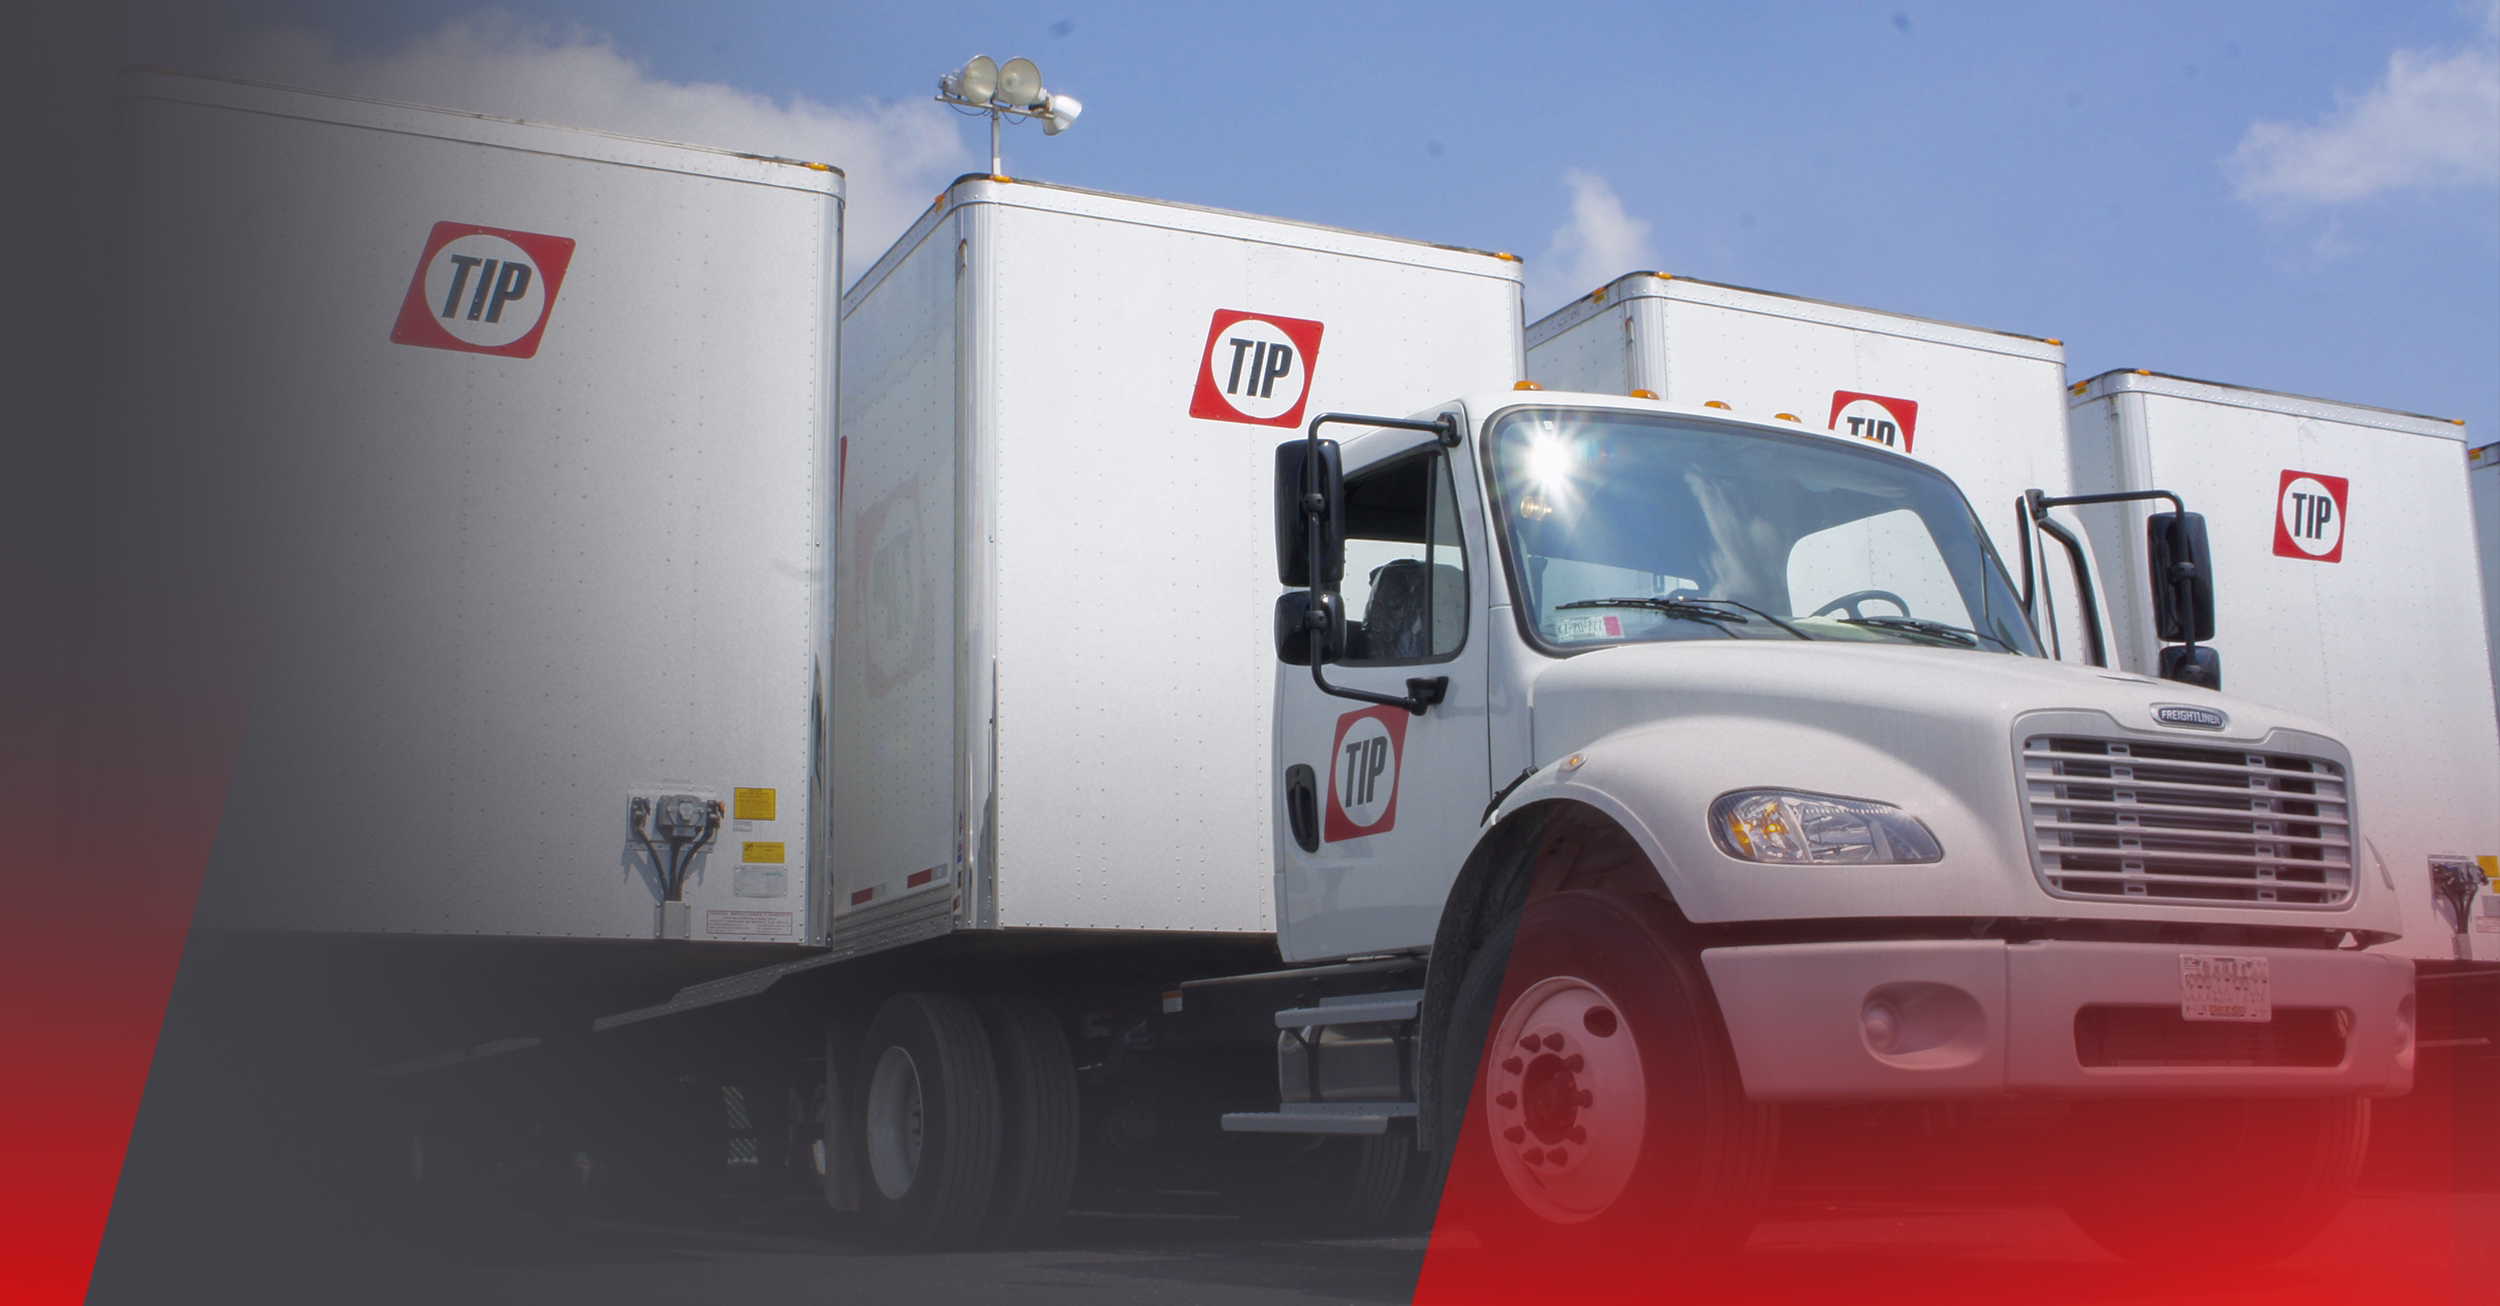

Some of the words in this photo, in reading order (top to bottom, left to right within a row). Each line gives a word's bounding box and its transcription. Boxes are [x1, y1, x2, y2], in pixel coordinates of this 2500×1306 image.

[442, 254, 532, 324] TIP
[1227, 338, 1293, 399] TIP
[2292, 492, 2332, 540] TIP
[2161, 710, 2220, 724] FREIGHTLINER
[1345, 736, 1388, 808] TIP
